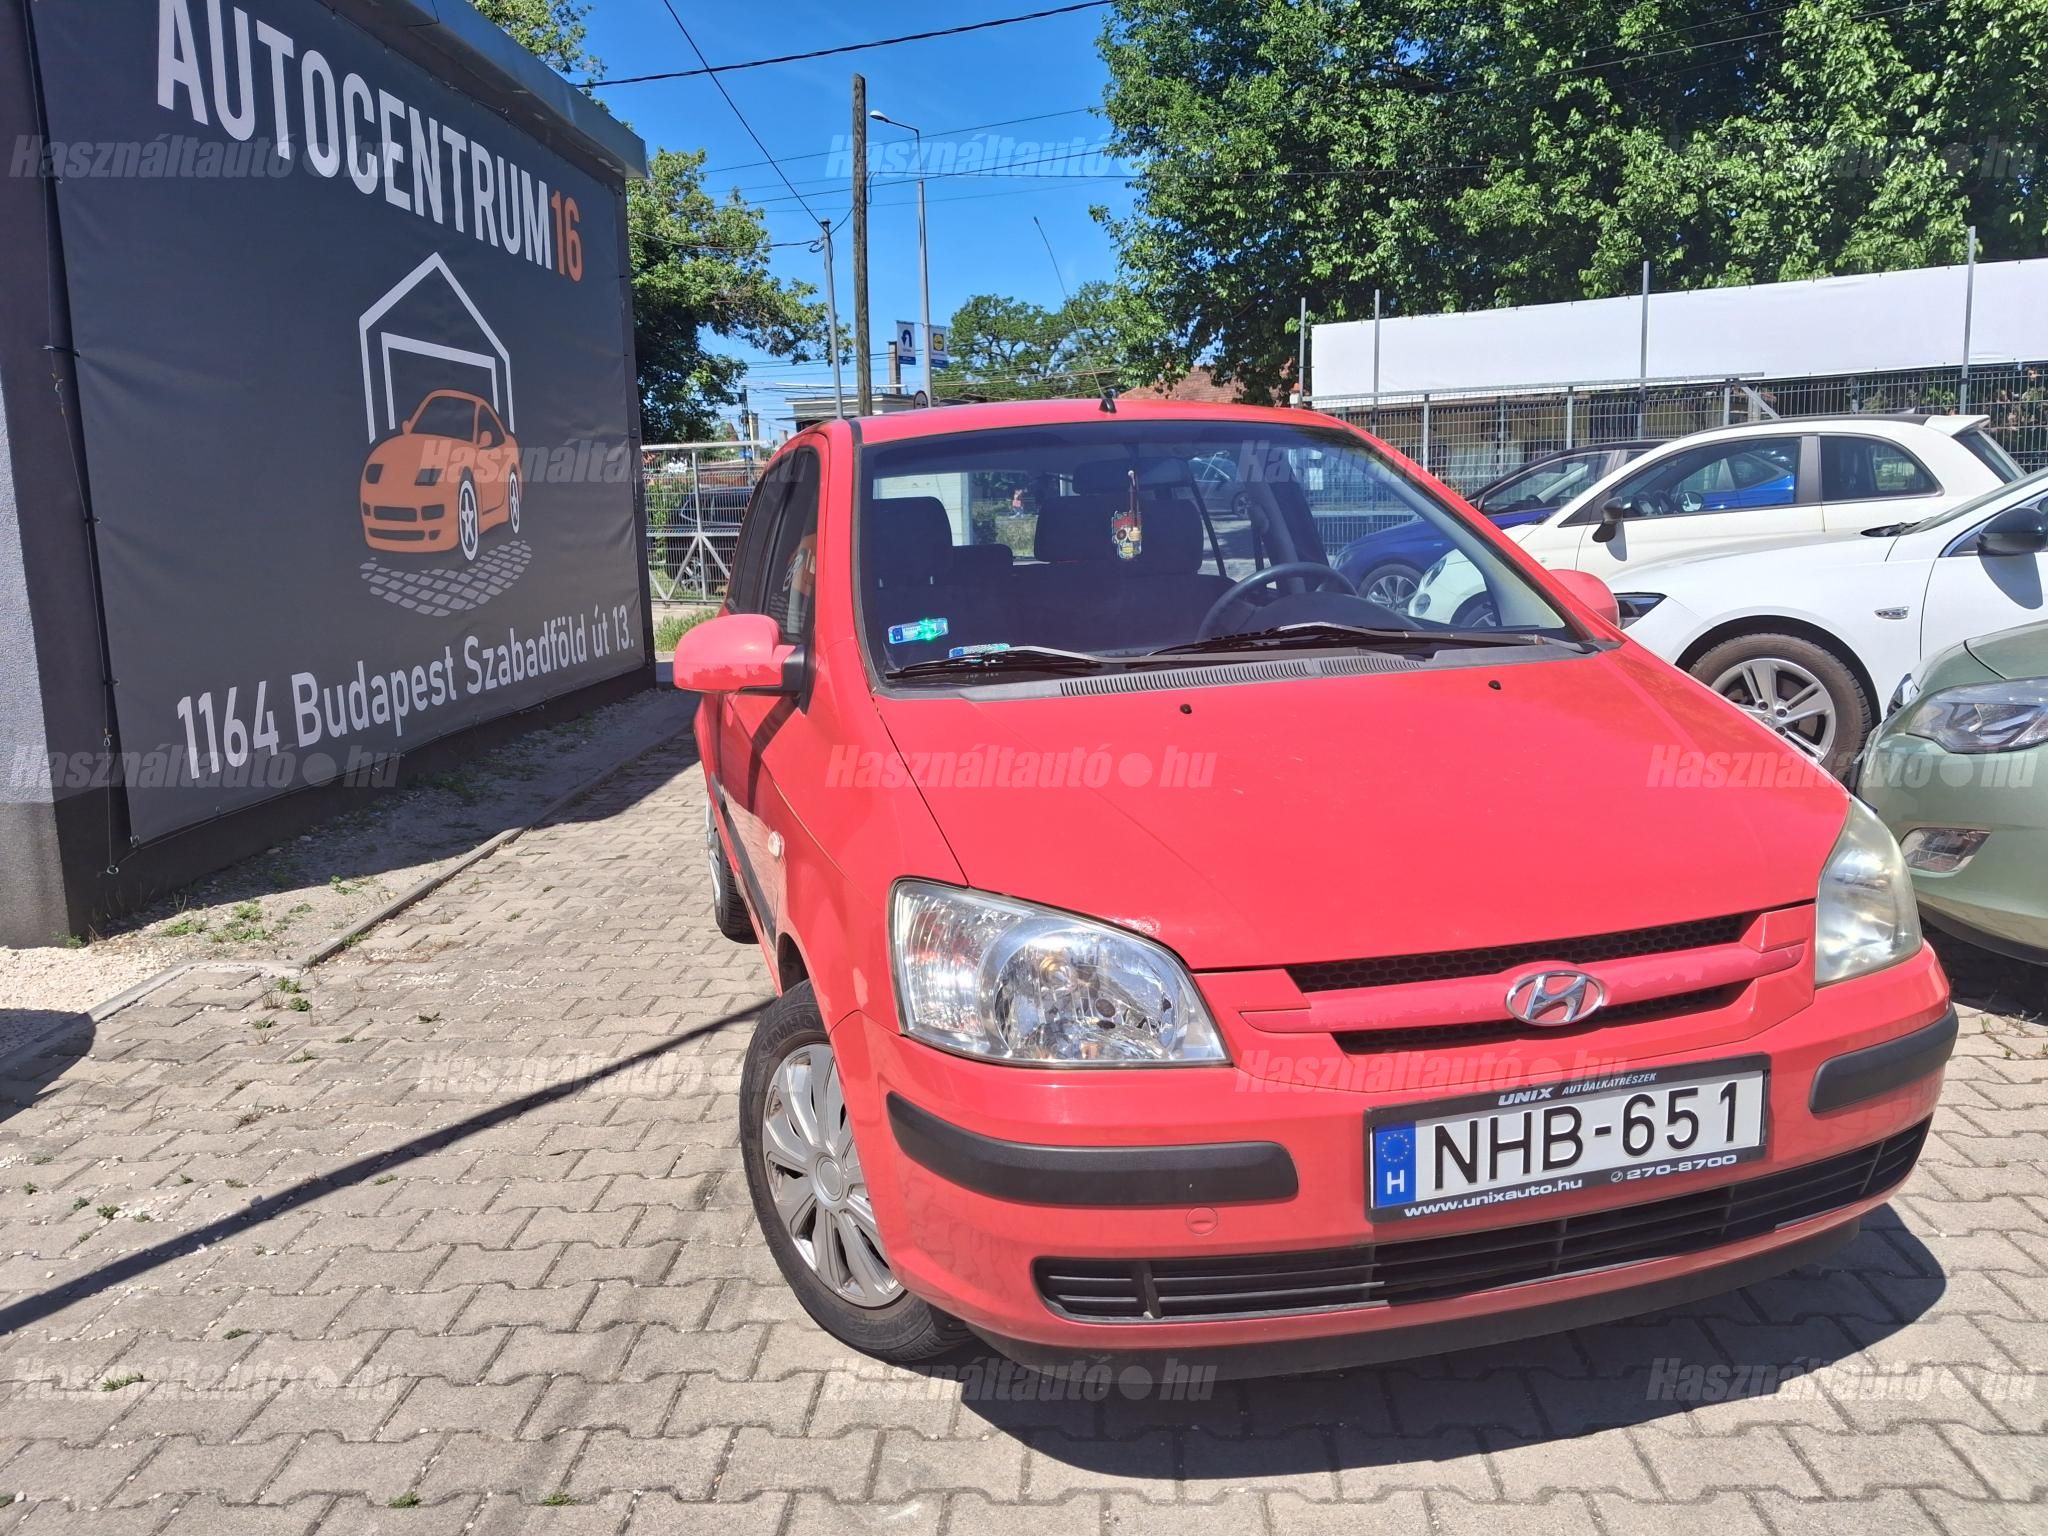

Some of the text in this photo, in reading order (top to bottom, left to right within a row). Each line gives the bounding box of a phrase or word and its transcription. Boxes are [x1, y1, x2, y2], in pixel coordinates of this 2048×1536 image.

[177, 680, 280, 780] 1164
[292, 645, 457, 747] Budapest
[463, 616, 587, 696] Szabadföld
[593, 605, 609, 660] út
[1498, 1087, 1554, 1106] UNIX
[1433, 1081, 1738, 1191] NHB-651
[1386, 1169, 1405, 1195] H
[1626, 1154, 1737, 1181] 270-8700
[1404, 1178, 1583, 1218] www.unixauto.hu
